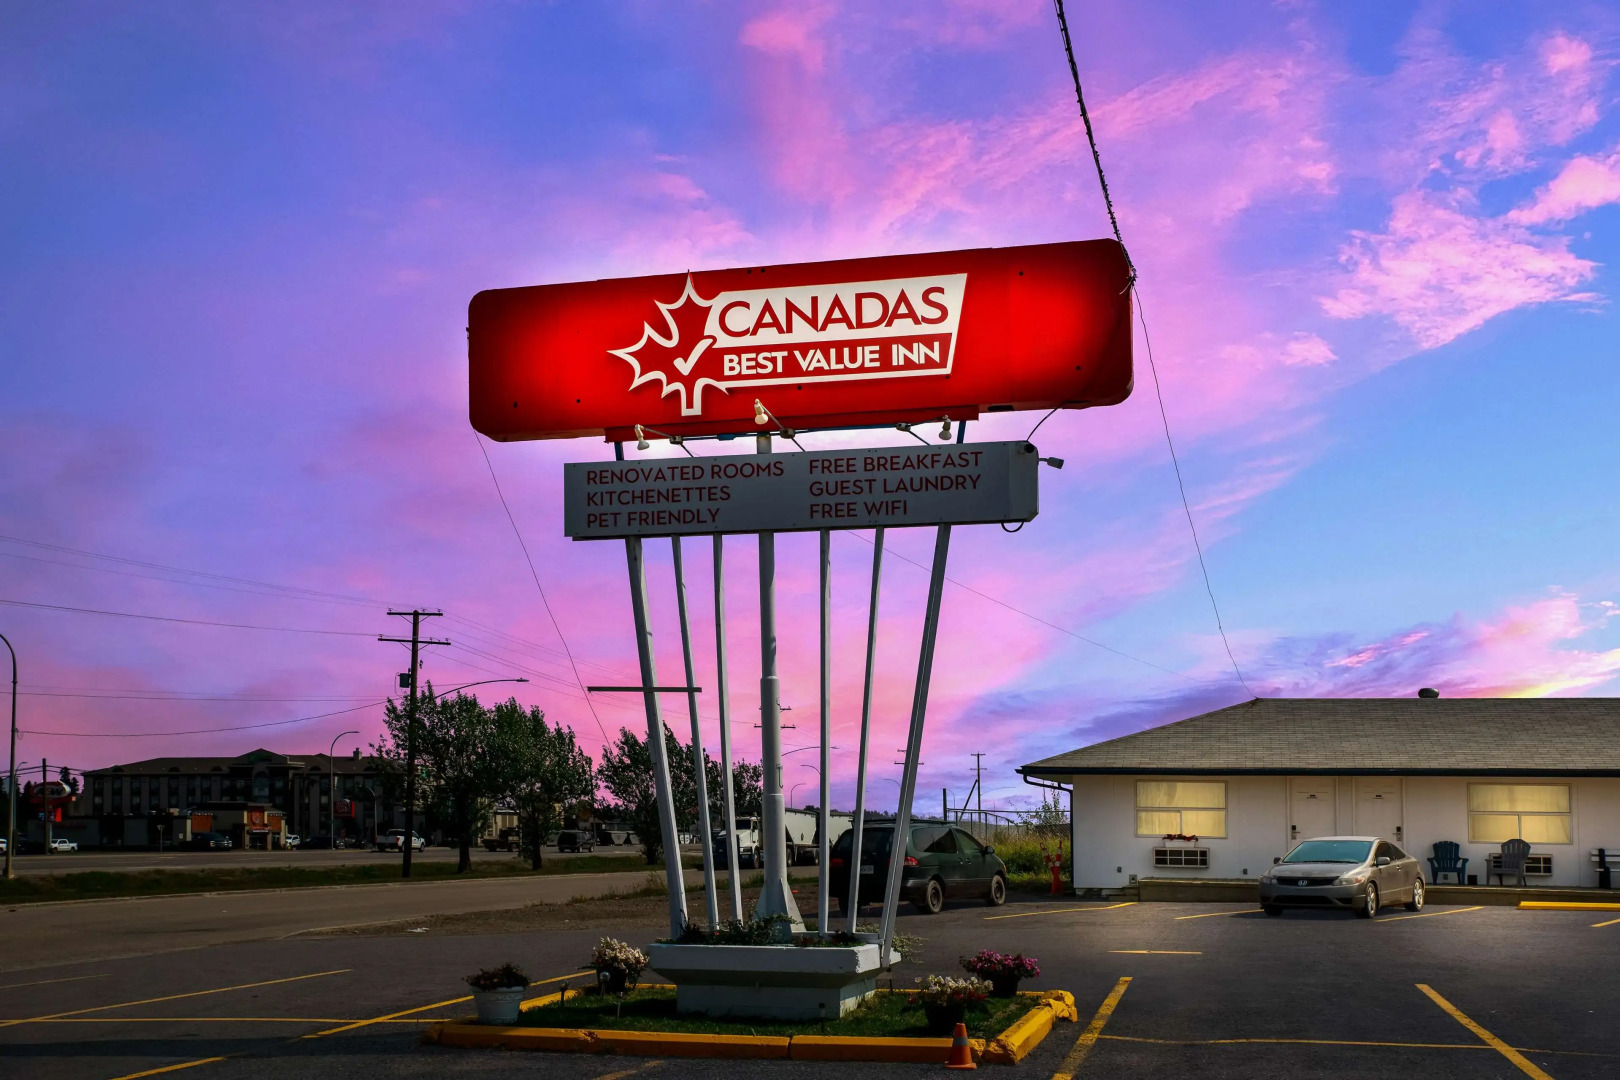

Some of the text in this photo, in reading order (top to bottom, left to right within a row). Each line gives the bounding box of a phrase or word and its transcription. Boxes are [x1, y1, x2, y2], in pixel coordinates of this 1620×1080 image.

[718, 286, 949, 338] CANADAS
[723, 341, 940, 376] BEST VALUE INN
[586, 461, 785, 485] RENOVATED ROOMS
[809, 451, 983, 475] FREE BREAKFAST
[586, 485, 731, 507] KITCHENETTES
[809, 473, 982, 497] GUEST LAUNDRY
[587, 508, 720, 528] PET FRIENDLY
[809, 499, 908, 519] FREE WIFI
